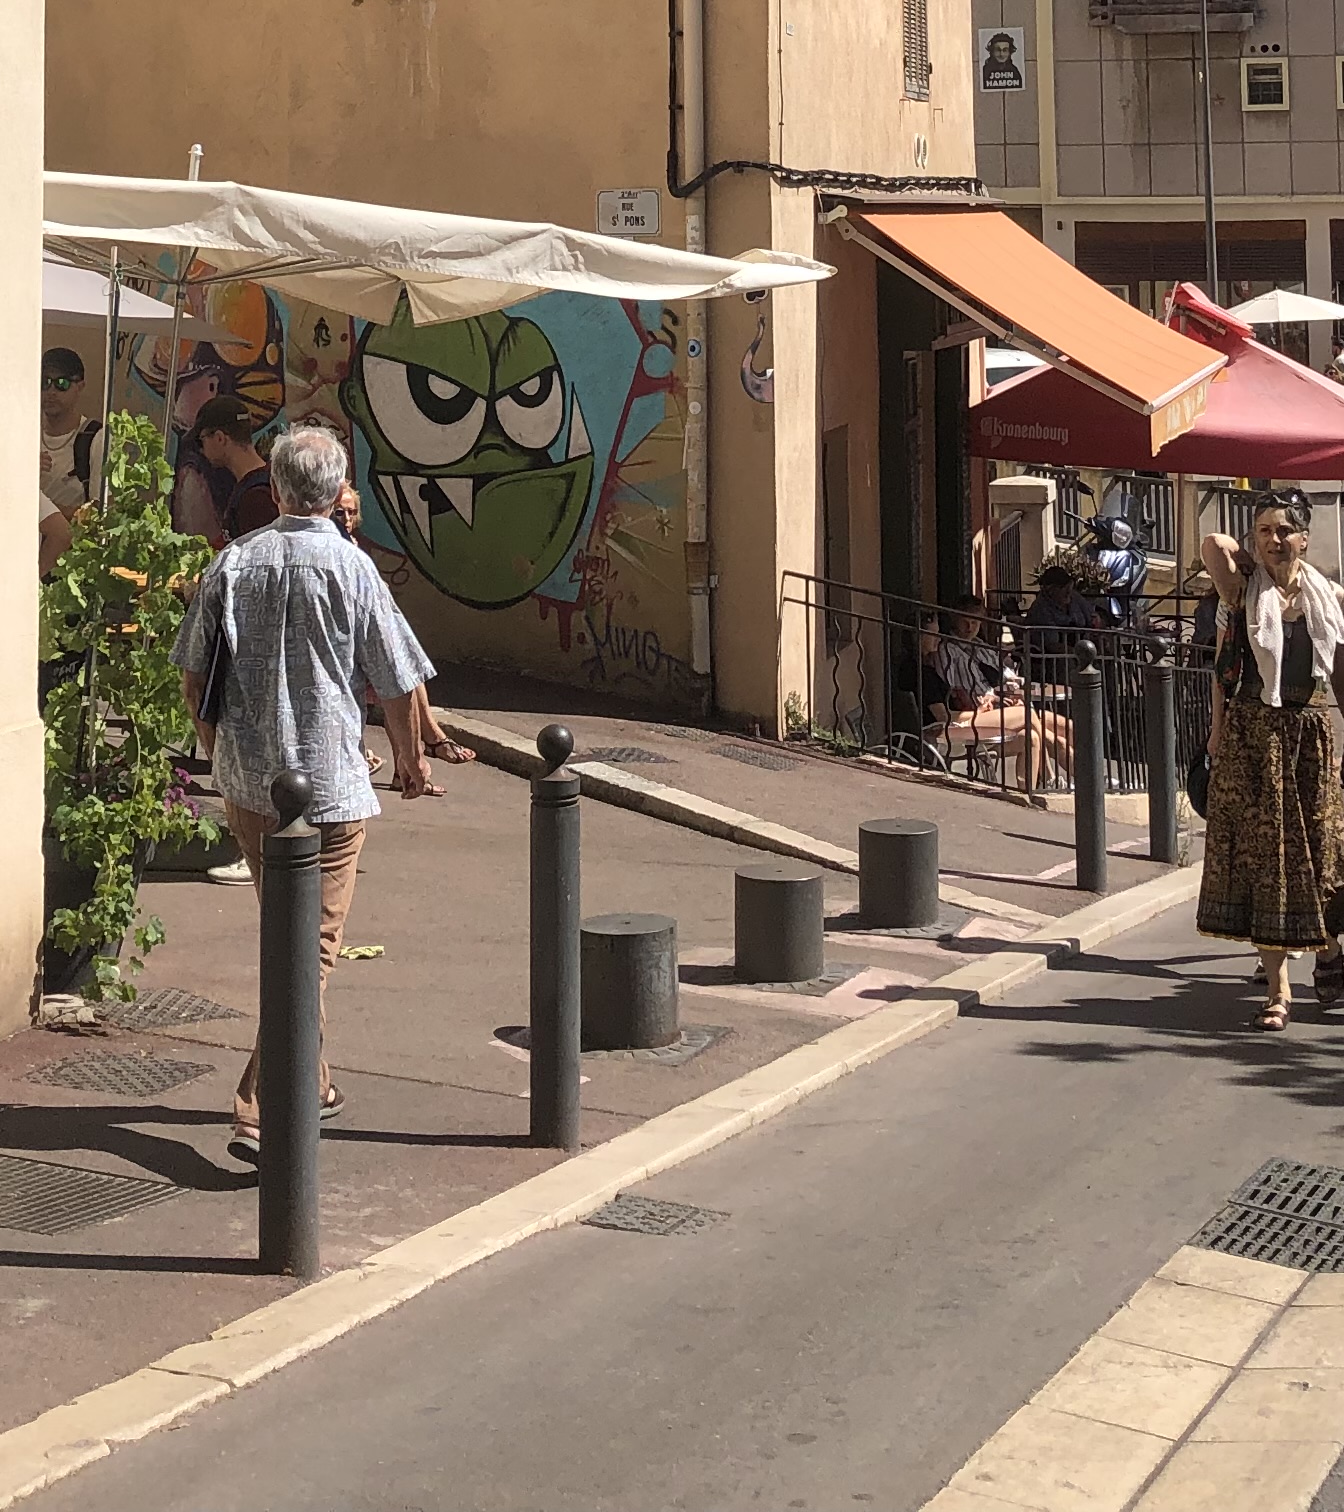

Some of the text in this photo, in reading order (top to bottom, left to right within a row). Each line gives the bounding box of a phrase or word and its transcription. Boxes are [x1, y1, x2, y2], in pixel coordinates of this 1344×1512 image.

[990, 72, 1014, 80] JOHN
[622, 202, 634, 211] RUE
[624, 216, 646, 226] PONS
[993, 418, 1069, 446] Kronenbourg
